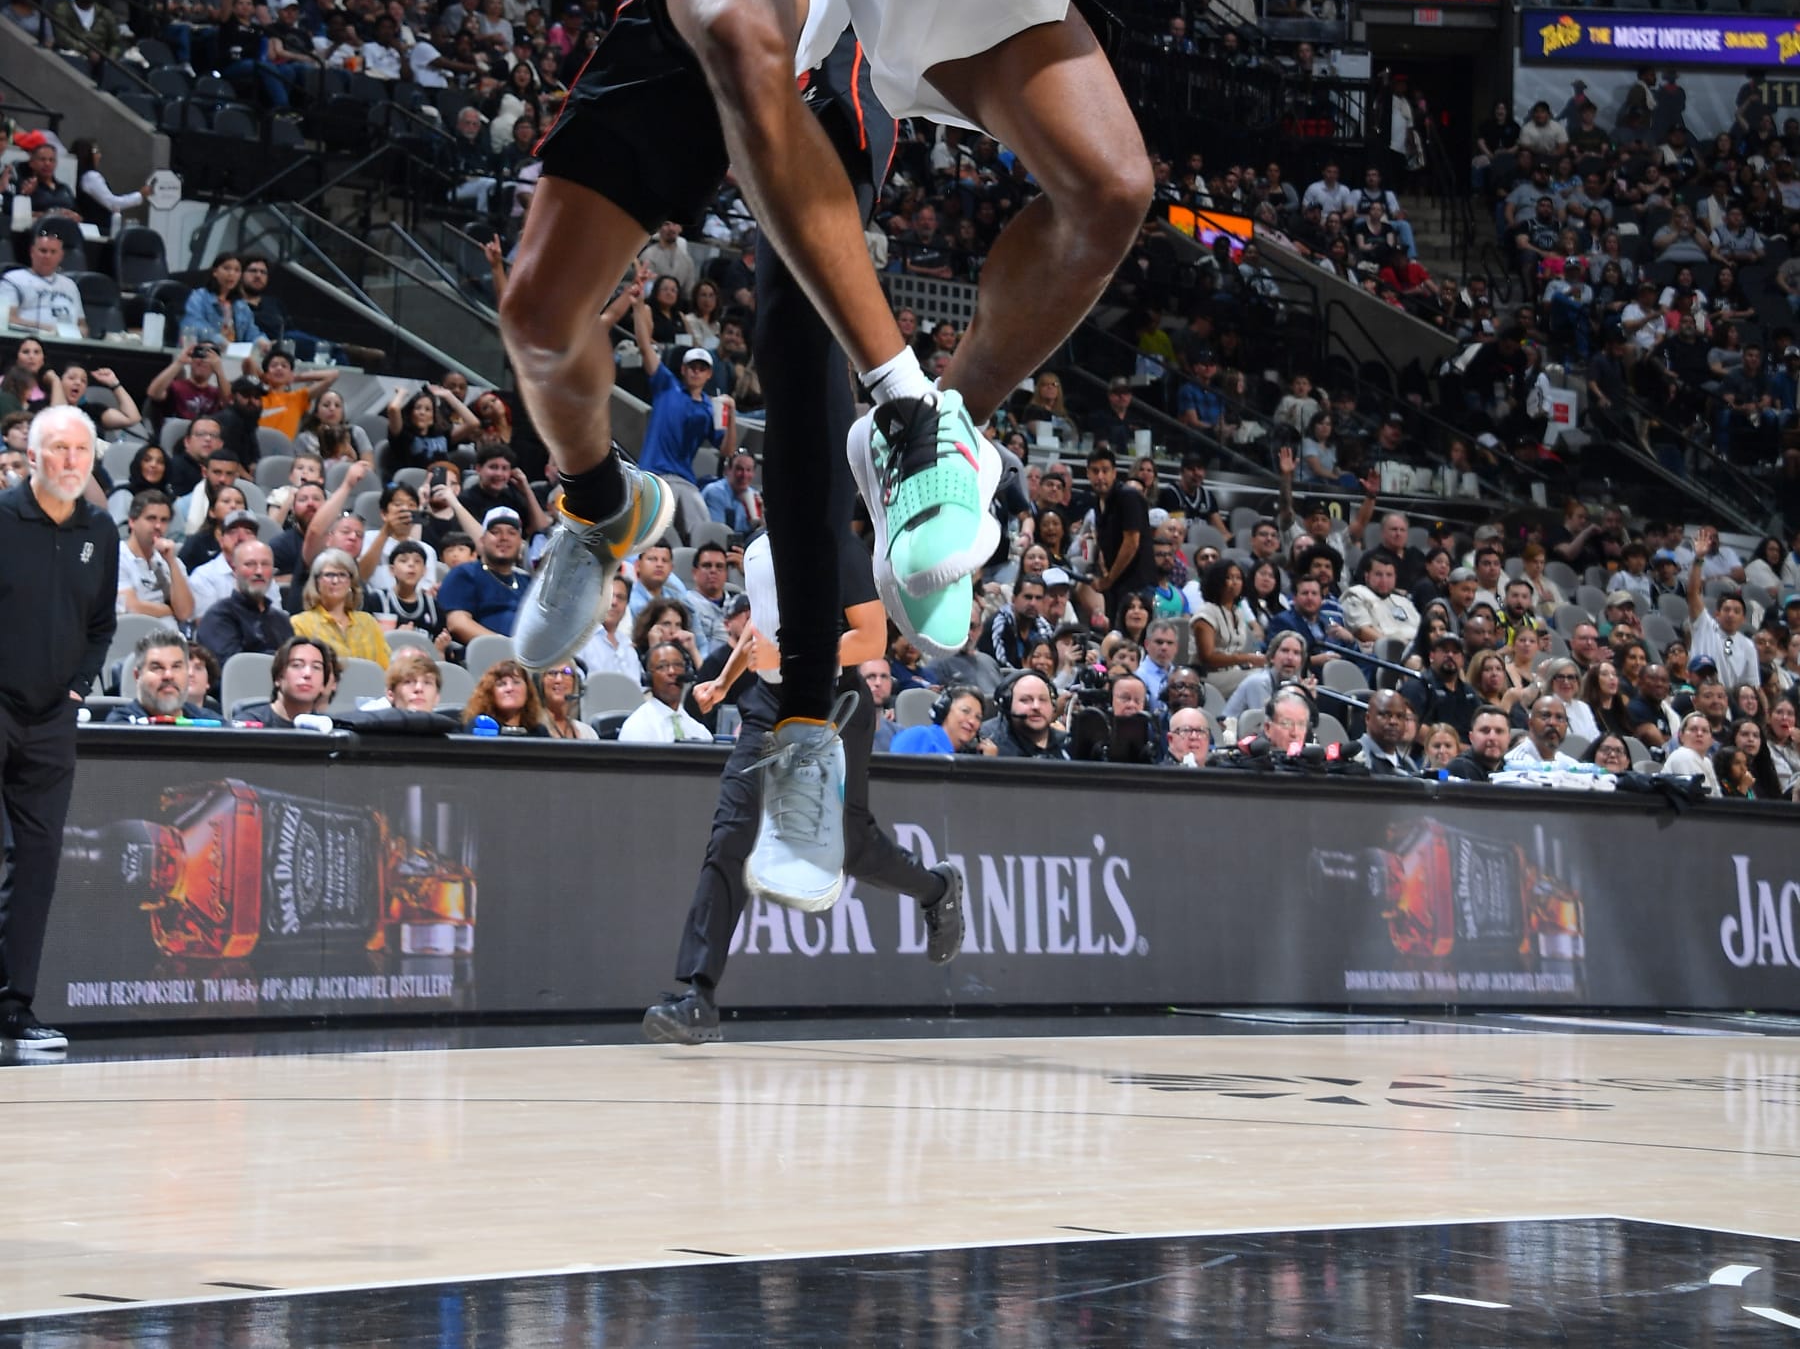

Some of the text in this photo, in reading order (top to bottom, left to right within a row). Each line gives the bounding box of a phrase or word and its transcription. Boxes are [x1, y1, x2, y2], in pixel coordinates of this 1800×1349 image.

[1613, 26, 1656, 49] MOST
[1657, 27, 1722, 52] INTENSE
[1758, 82, 1798, 106] 111
[67, 981, 108, 1007] DRINK
